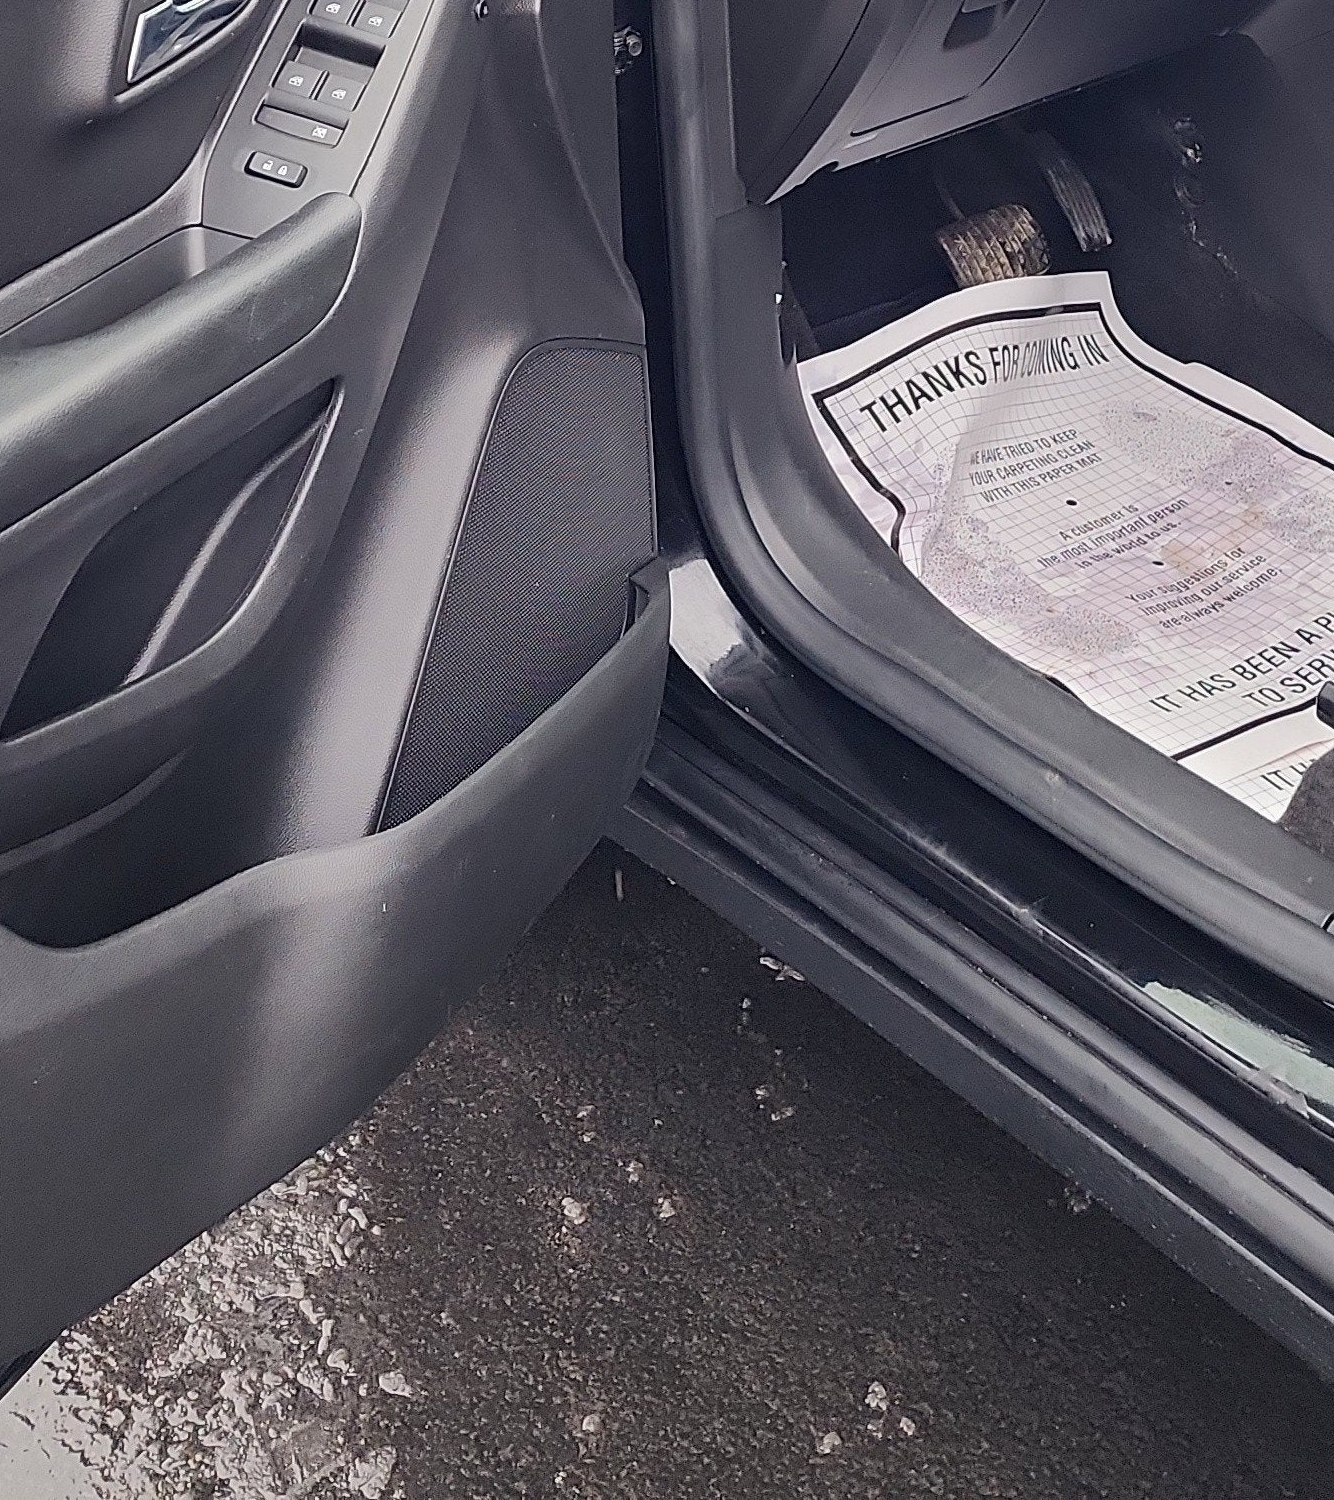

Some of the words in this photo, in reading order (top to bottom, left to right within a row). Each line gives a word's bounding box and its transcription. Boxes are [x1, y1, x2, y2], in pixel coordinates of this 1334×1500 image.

[859, 350, 988, 433] THANKS
[988, 344, 1019, 384] FOR
[1020, 336, 1080, 378] COMING
[1077, 334, 1110, 366] IN
[969, 468, 997, 487] YOUR
[996, 452, 1058, 481] CARPETING
[1057, 440, 1096, 460] CLEAN
[981, 447, 1004, 465] HAVE
[1002, 441, 1035, 459] TRIED
[1033, 437, 1052, 450] TO
[1049, 428, 1078, 446] KEEP
[980, 485, 1013, 503] WITH
[1011, 476, 1041, 493] THIS
[1038, 463, 1079, 483] PAPER
[1075, 452, 1103, 469] MAT
[1037, 554, 1061, 568] the
[1060, 542, 1090, 562] most
[1090, 517, 1148, 548] important
[1147, 499, 1190, 524] person
[1058, 530, 1072, 542] A
[1071, 509, 1126, 538] customer
[1089, 552, 1113, 563] the
[1111, 538, 1147, 556] world
[1144, 529, 1161, 540] to
[1161, 521, 1182, 533] us.
[1125, 589, 1158, 603] Your
[1157, 559, 1229, 595] suggestions
[1224, 546, 1246, 561] for
[1200, 580, 1224, 597] our
[1221, 554, 1267, 585] service
[1159, 617, 1182, 629] are
[1180, 599, 1225, 622] always
[1148, 693, 1183, 713] IT
[1177, 673, 1237, 702] HAS
[1229, 640, 1302, 682] BEEN
[1294, 627, 1323, 645] A
[1241, 686, 1286, 707] TO
[1260, 769, 1295, 791] IT
